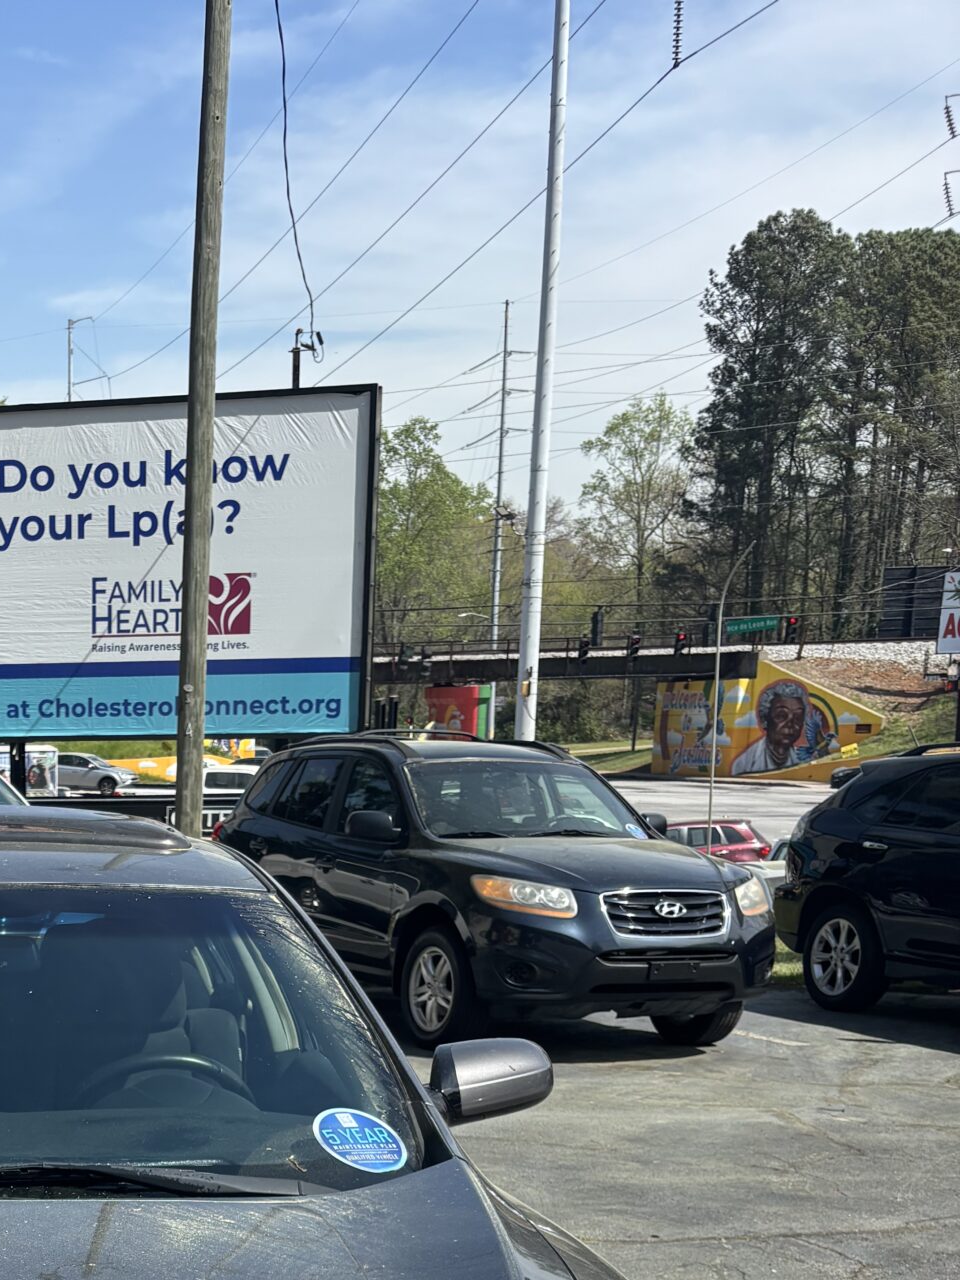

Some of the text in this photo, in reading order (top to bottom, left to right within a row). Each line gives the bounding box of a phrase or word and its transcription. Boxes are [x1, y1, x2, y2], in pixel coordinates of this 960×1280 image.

[67, 460, 147, 500] you
[164, 449, 291, 486] kow
[91, 576, 184, 604] FAMILY
[91, 604, 182, 634] HEART
[91, 643, 126, 655] Raising
[221, 640, 250, 651] Lives.
[5, 700, 31, 719] at
[38, 694, 342, 720] Cholesterolonnect.org
[321, 1127, 393, 1145] 5 YEAR
